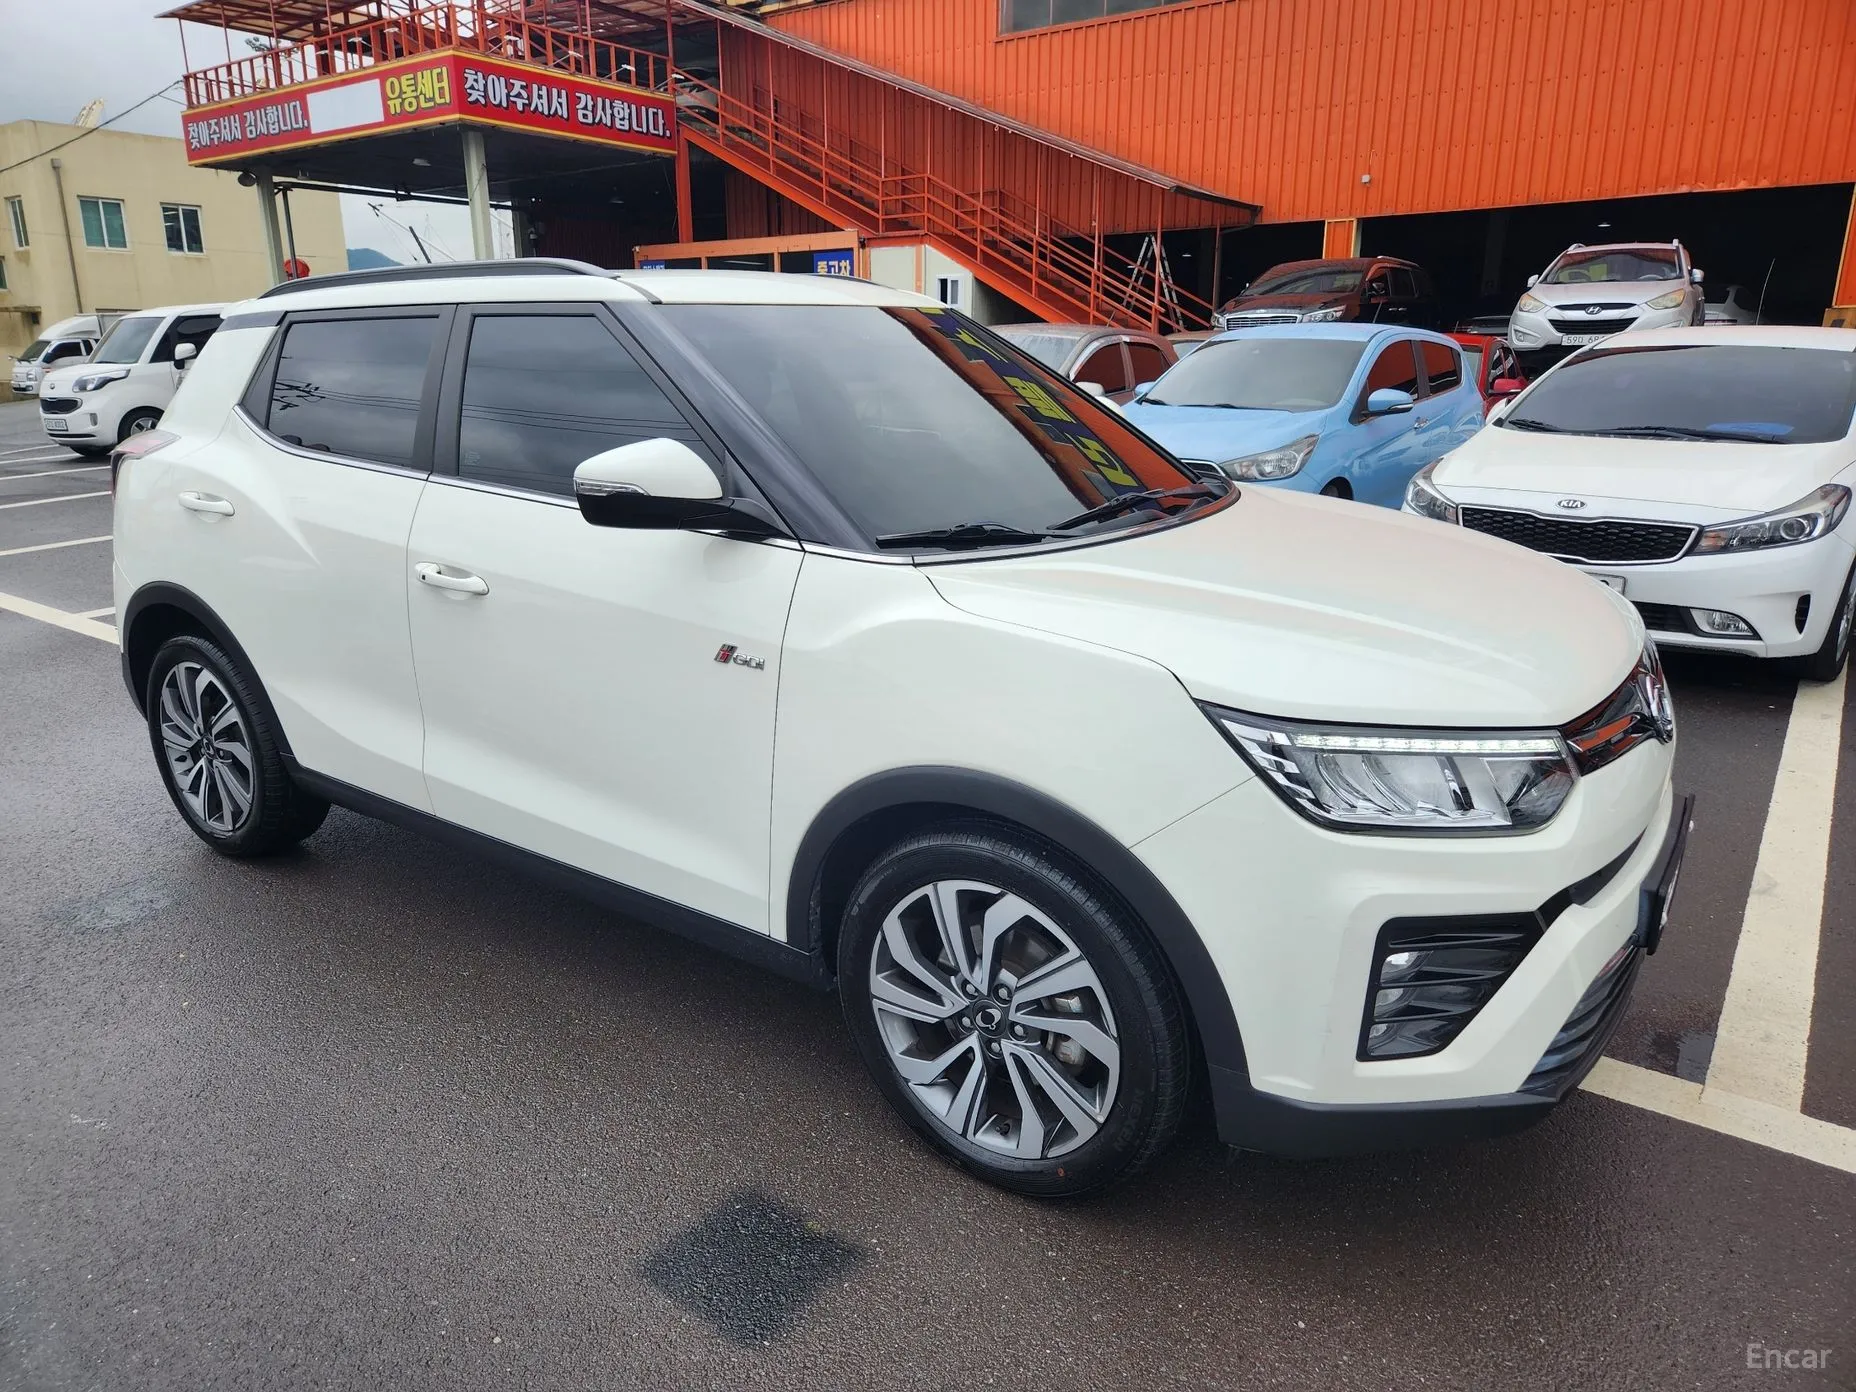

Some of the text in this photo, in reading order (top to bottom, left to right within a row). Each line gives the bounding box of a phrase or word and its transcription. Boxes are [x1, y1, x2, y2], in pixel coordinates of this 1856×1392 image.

[385, 66, 451, 115] 유통센터
[463, 69, 672, 138] 찾아주셔서 감사합니다.
[187, 100, 309, 150] 찾아주셔서 감사합니다.
[1560, 500, 1581, 508] KIA
